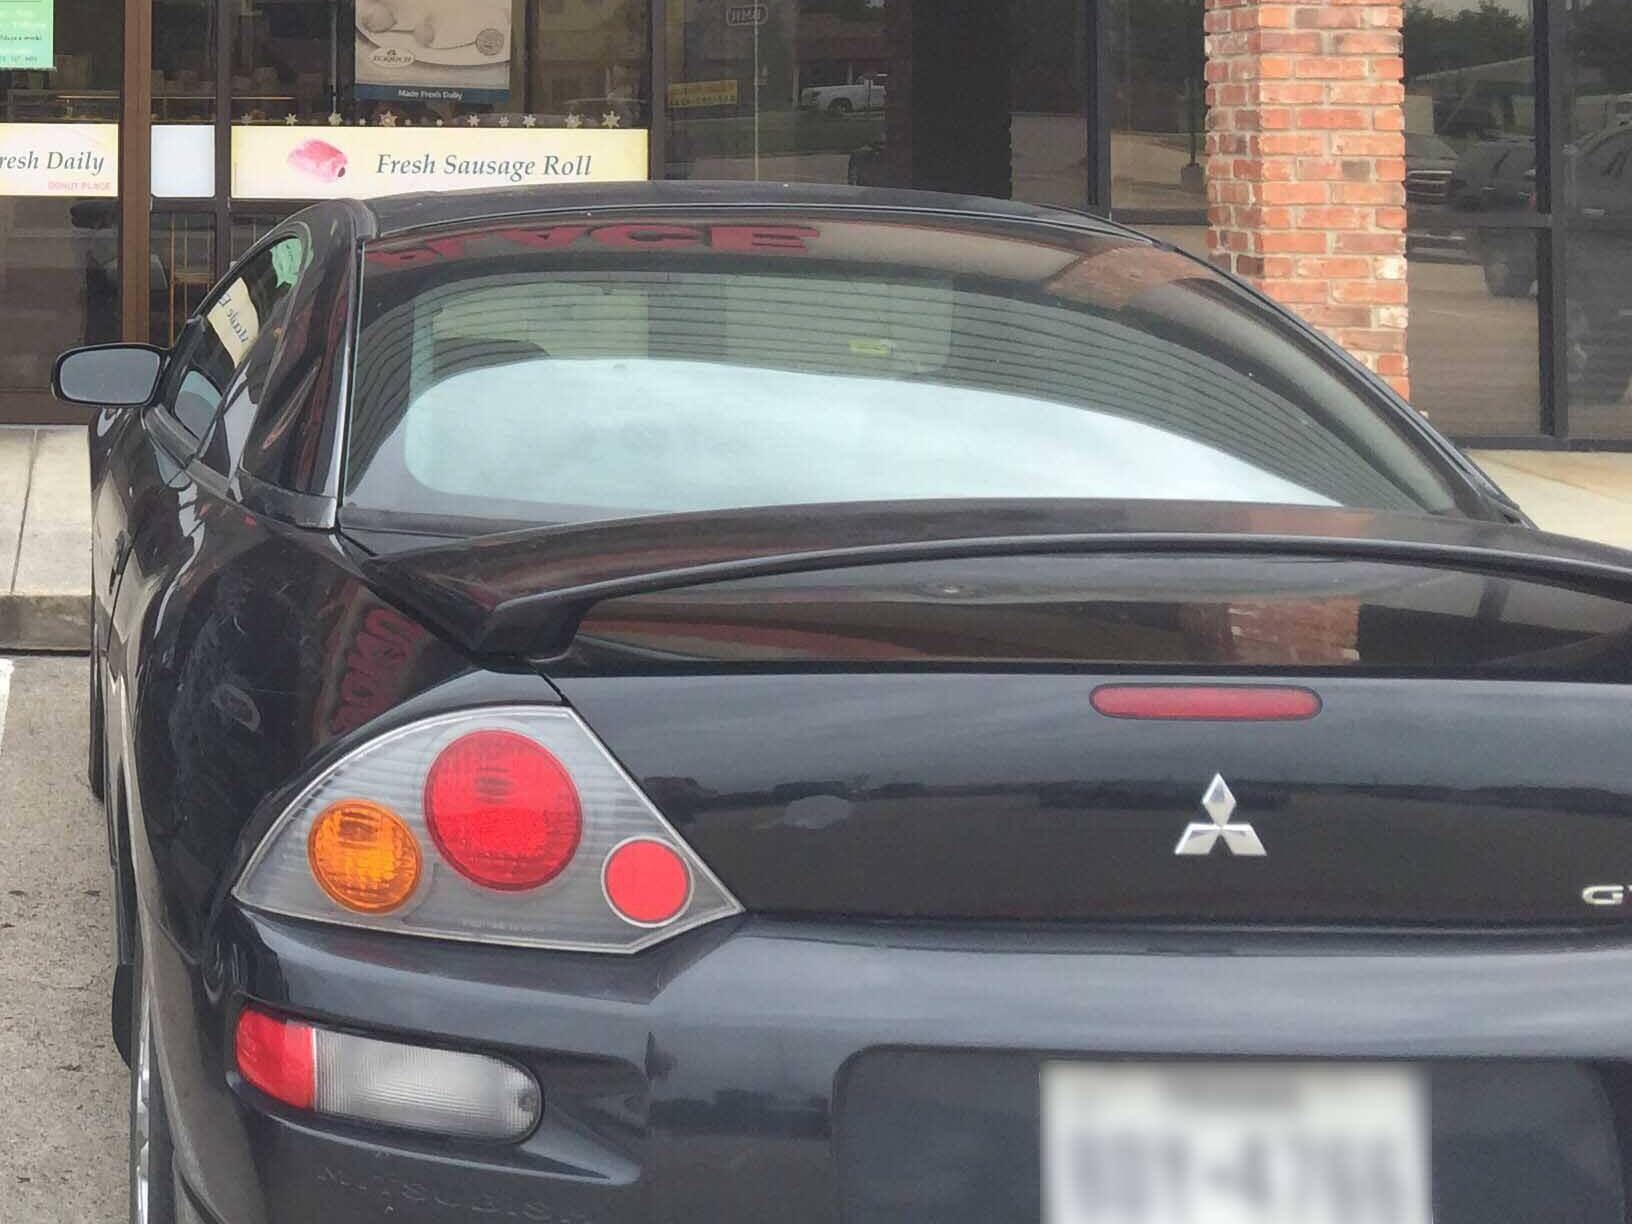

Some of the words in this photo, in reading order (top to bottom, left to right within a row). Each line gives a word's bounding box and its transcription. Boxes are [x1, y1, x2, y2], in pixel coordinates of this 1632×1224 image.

[397, 88, 419, 99] Made
[420, 90, 442, 100] Fresh
[47, 150, 105, 176] Daily
[375, 153, 436, 175] Fresh
[443, 154, 536, 183] Sausage
[541, 154, 593, 176] Roll
[48, 181, 79, 191] DONUT
[1581, 884, 1632, 907] G
